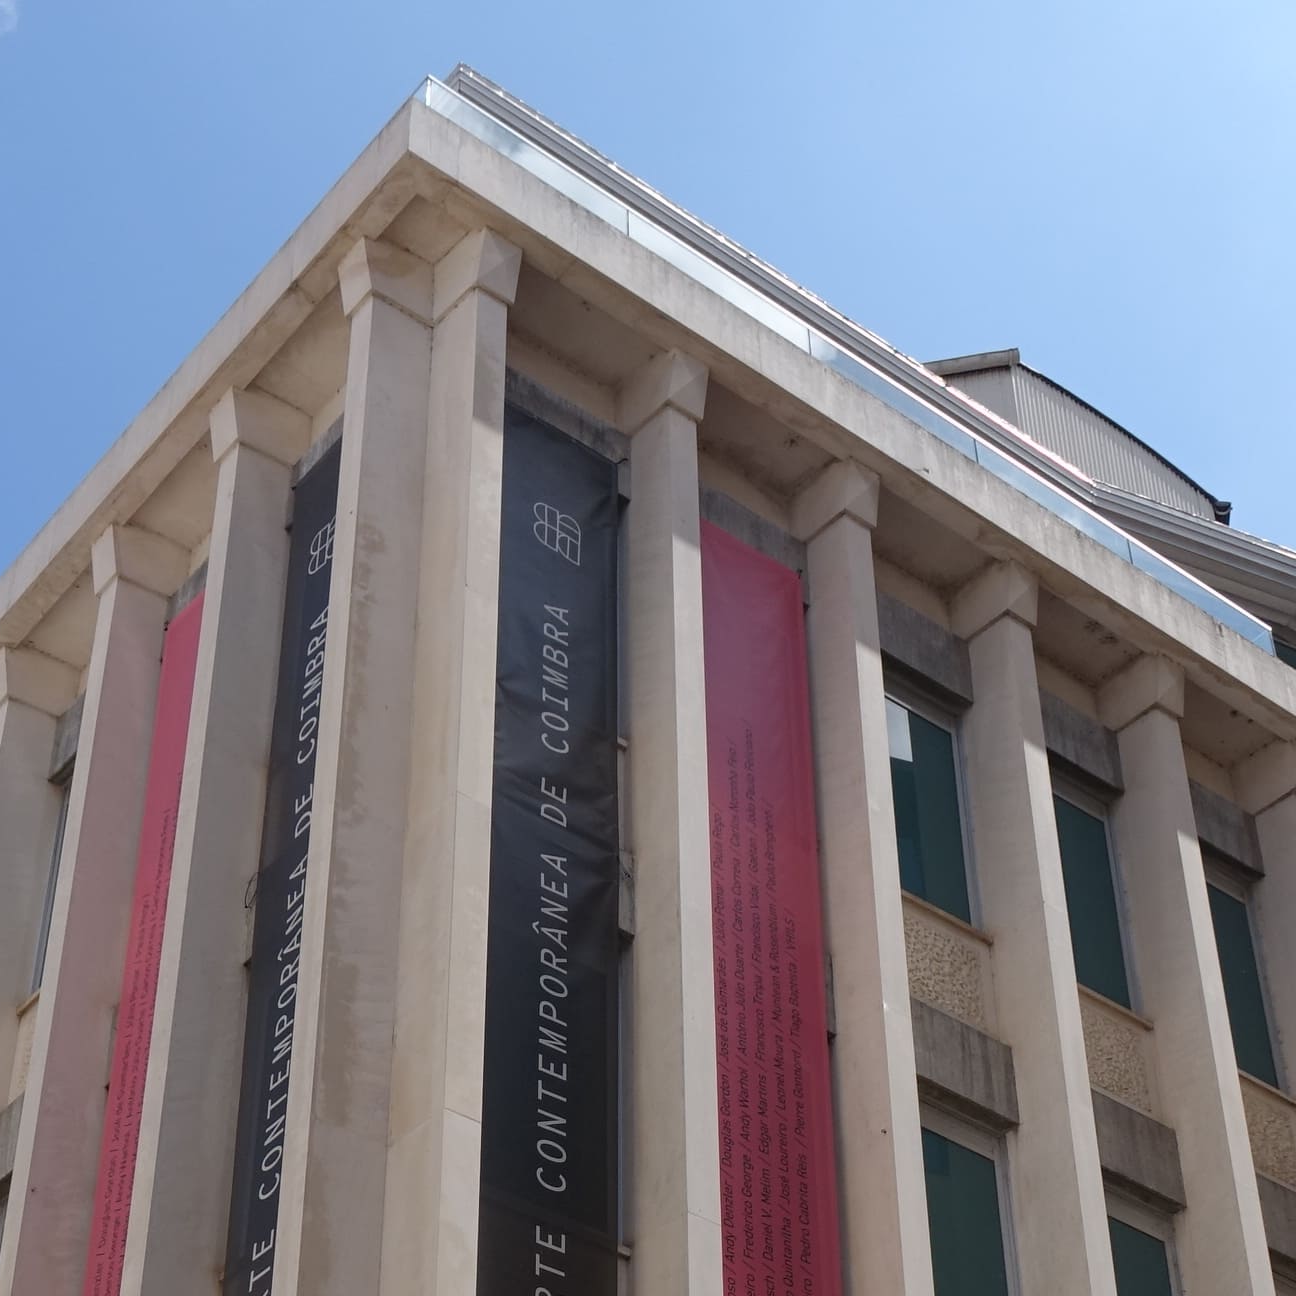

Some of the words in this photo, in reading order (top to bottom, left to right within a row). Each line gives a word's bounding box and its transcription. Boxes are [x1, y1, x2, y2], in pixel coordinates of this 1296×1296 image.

[296, 603, 329, 765] COIMBRA
[540, 602, 570, 755] COIMBRA
[292, 783, 315, 838] DE
[540, 777, 568, 829] DE
[732, 899, 743, 932] Carlos
[257, 856, 309, 1202] CONTEMPORÂNEA
[532, 852, 568, 1194] CONTEMPORÂNEA
[718, 1020, 728, 1032] de
[719, 1034, 729, 1062] José
[739, 1068, 750, 1108] Warhol
[758, 1074, 769, 1117] Martins
[740, 1112, 751, 1141] Andy
[758, 1121, 772, 1155] Edgar
[793, 1102, 806, 1137] Pierre
[721, 1119, 734, 1168] Douglas
[777, 1122, 788, 1173] Loureiro
[741, 1154, 754, 1197] George
[760, 1168, 772, 1205] Melim
[796, 1154, 807, 1179] Reis
[723, 1182, 734, 1228] Denzler
[779, 1175, 790, 1206] José
[798, 1182, 810, 1225] Cabrita
[725, 1232, 736, 1263] Andy
[743, 1201, 754, 1259] Frederico
[762, 1221, 774, 1261] Daniel
[800, 1229, 812, 1265] Pedro
[781, 1217, 794, 1288] Quintanilha
